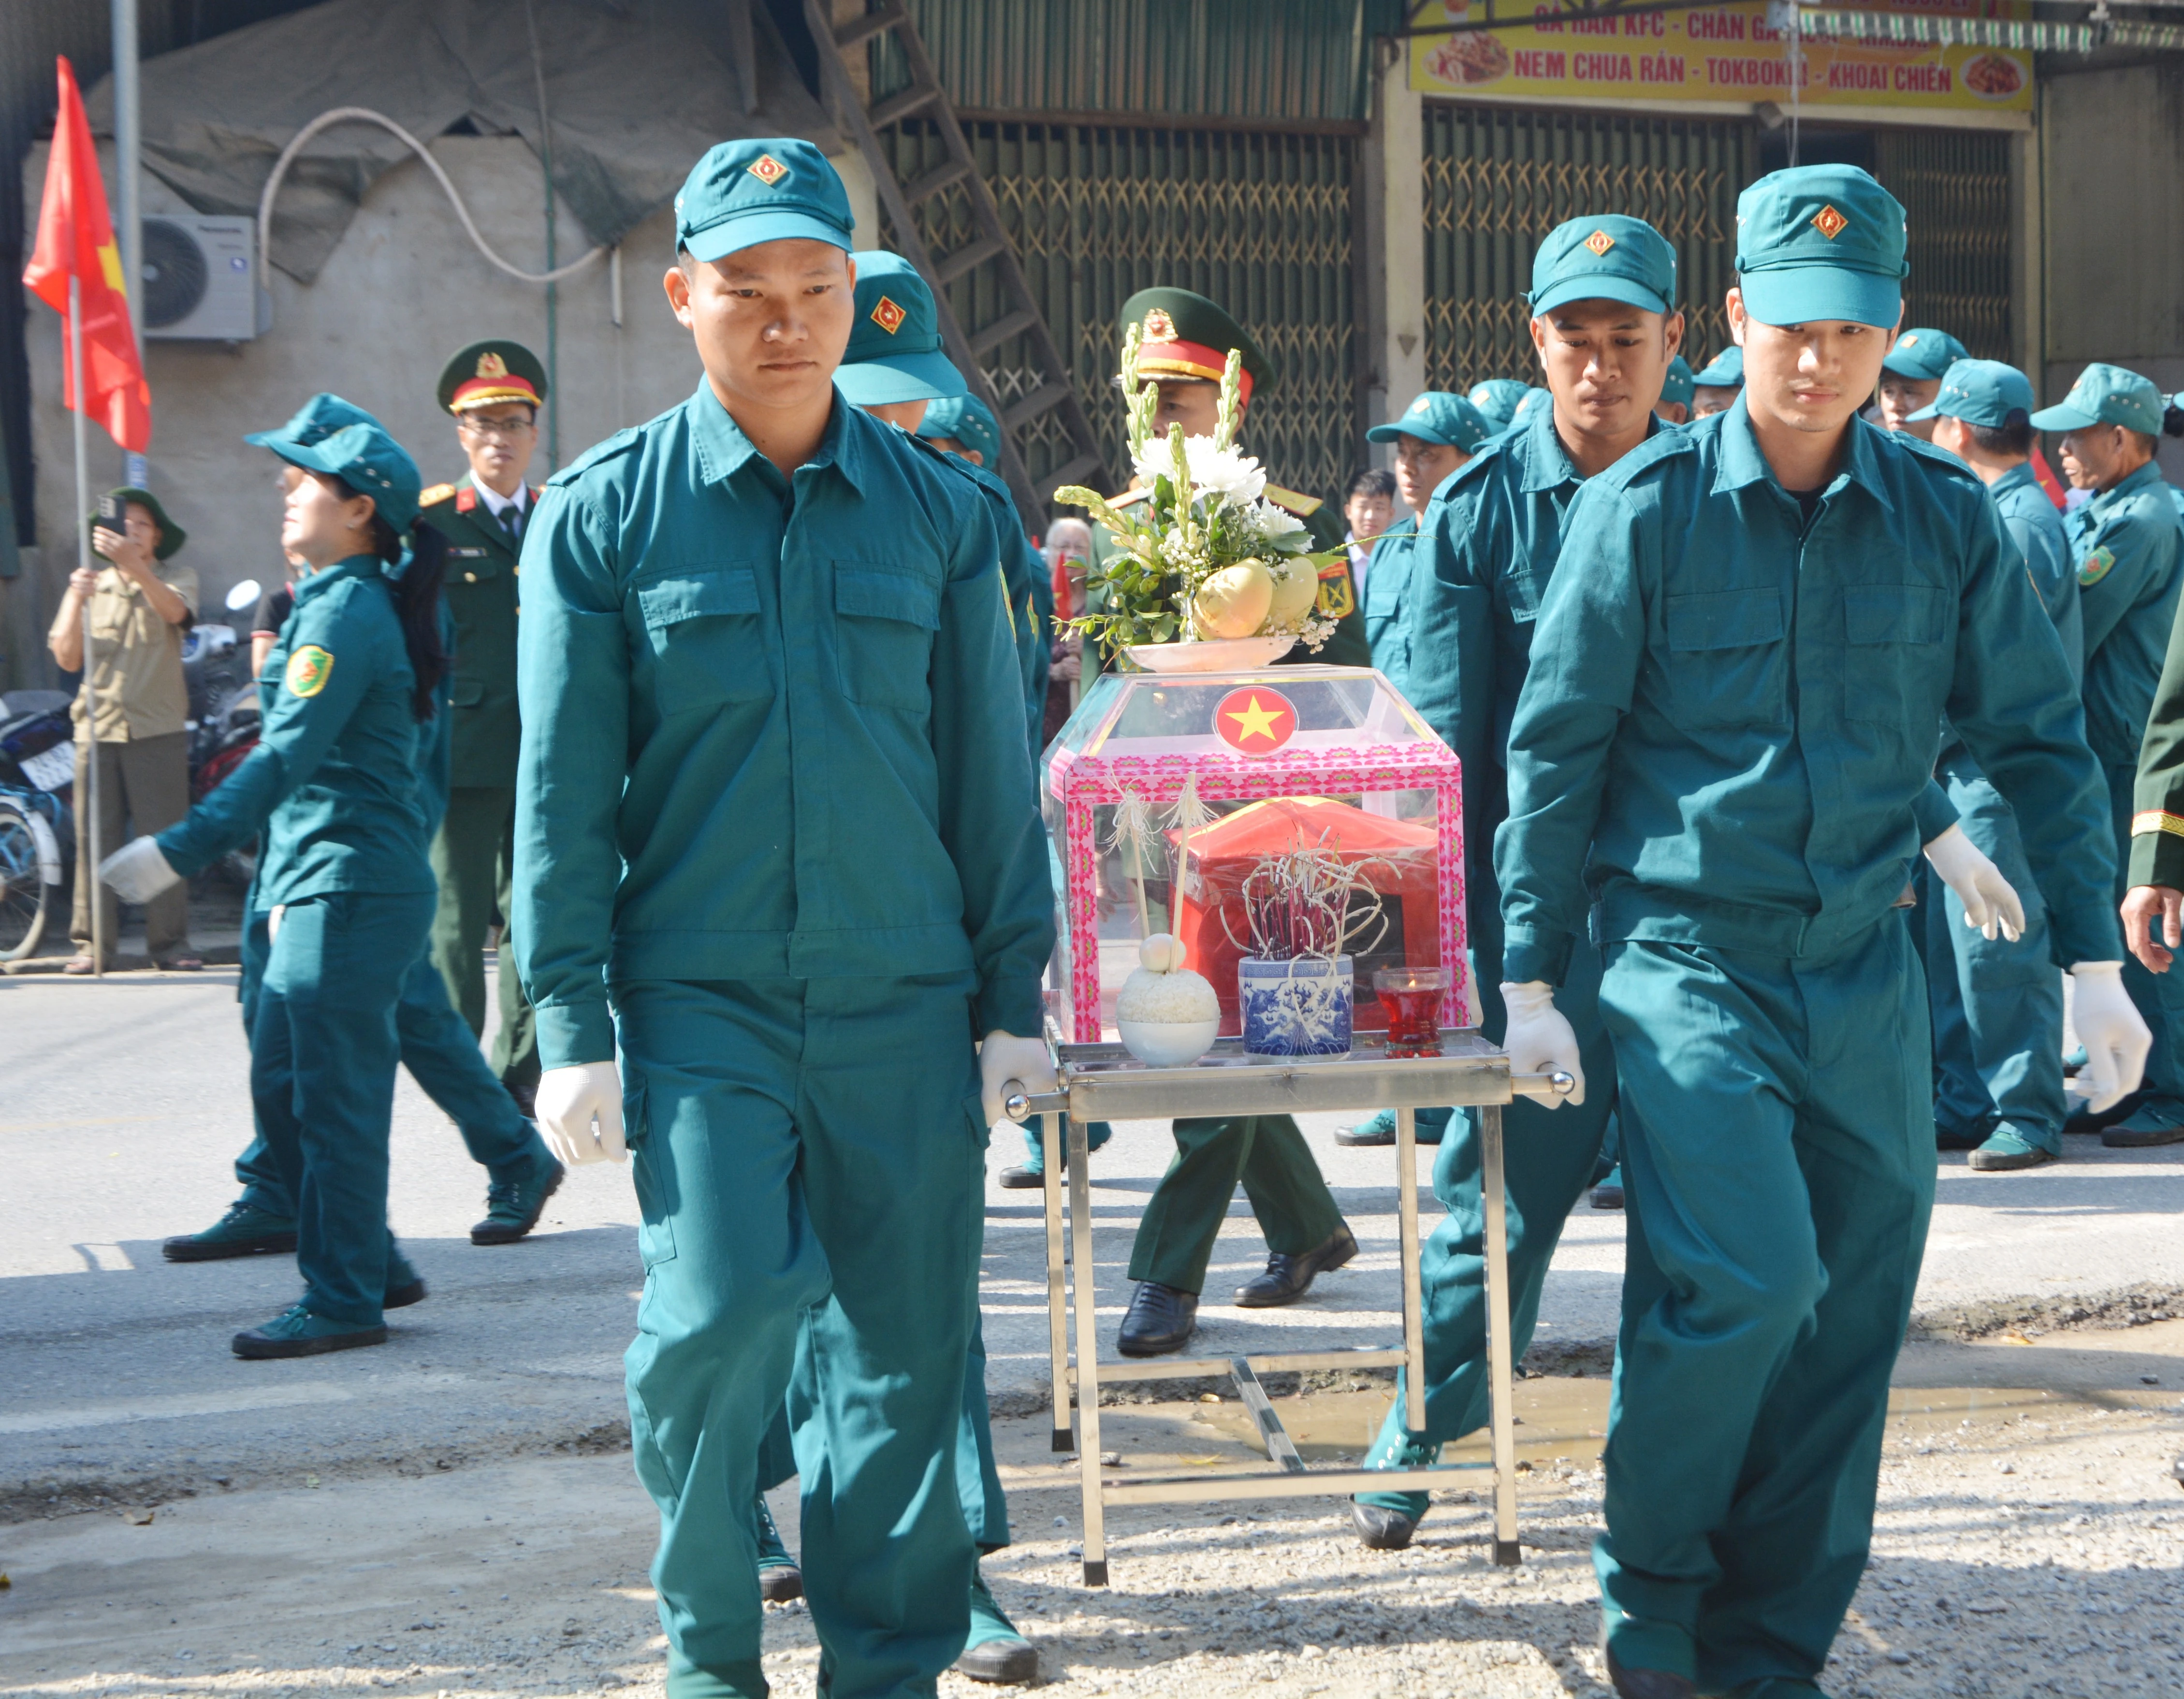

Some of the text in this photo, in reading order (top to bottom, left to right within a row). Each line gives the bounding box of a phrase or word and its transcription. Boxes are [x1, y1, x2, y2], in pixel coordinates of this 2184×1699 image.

[1624, 11, 1664, 37] KFC
[1687, 6, 1745, 40] CHÂN
[1514, 50, 1566, 78] NEM
[1573, 52, 1632, 81] CHUA
[1640, 49, 1685, 83] RÁN
[1829, 63, 1888, 90] KHOAI
[1894, 61, 1951, 92] CHIÊN
